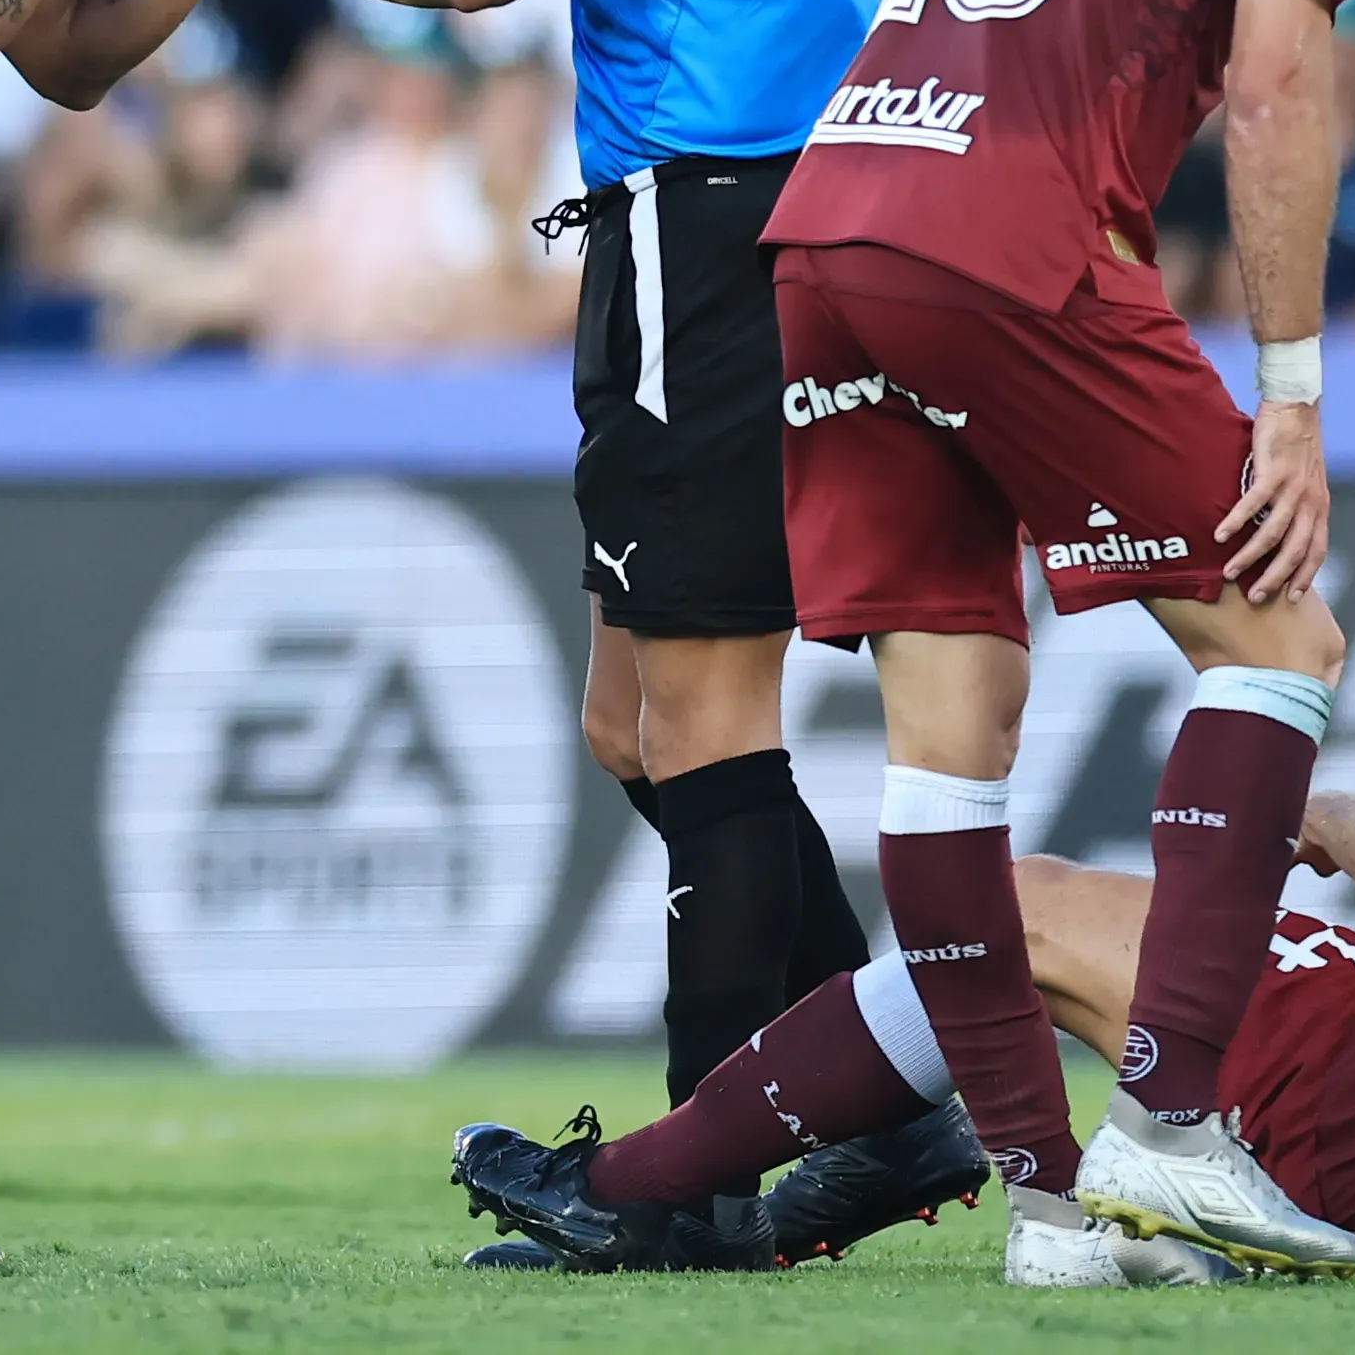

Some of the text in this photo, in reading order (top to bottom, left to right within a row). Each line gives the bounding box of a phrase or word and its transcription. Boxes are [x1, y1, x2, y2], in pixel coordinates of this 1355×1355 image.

[820, 75, 987, 132] artaSur
[1046, 532, 1190, 570] andina
[1089, 562, 1152, 575] PINTURAS
[212, 622, 469, 810] EA
